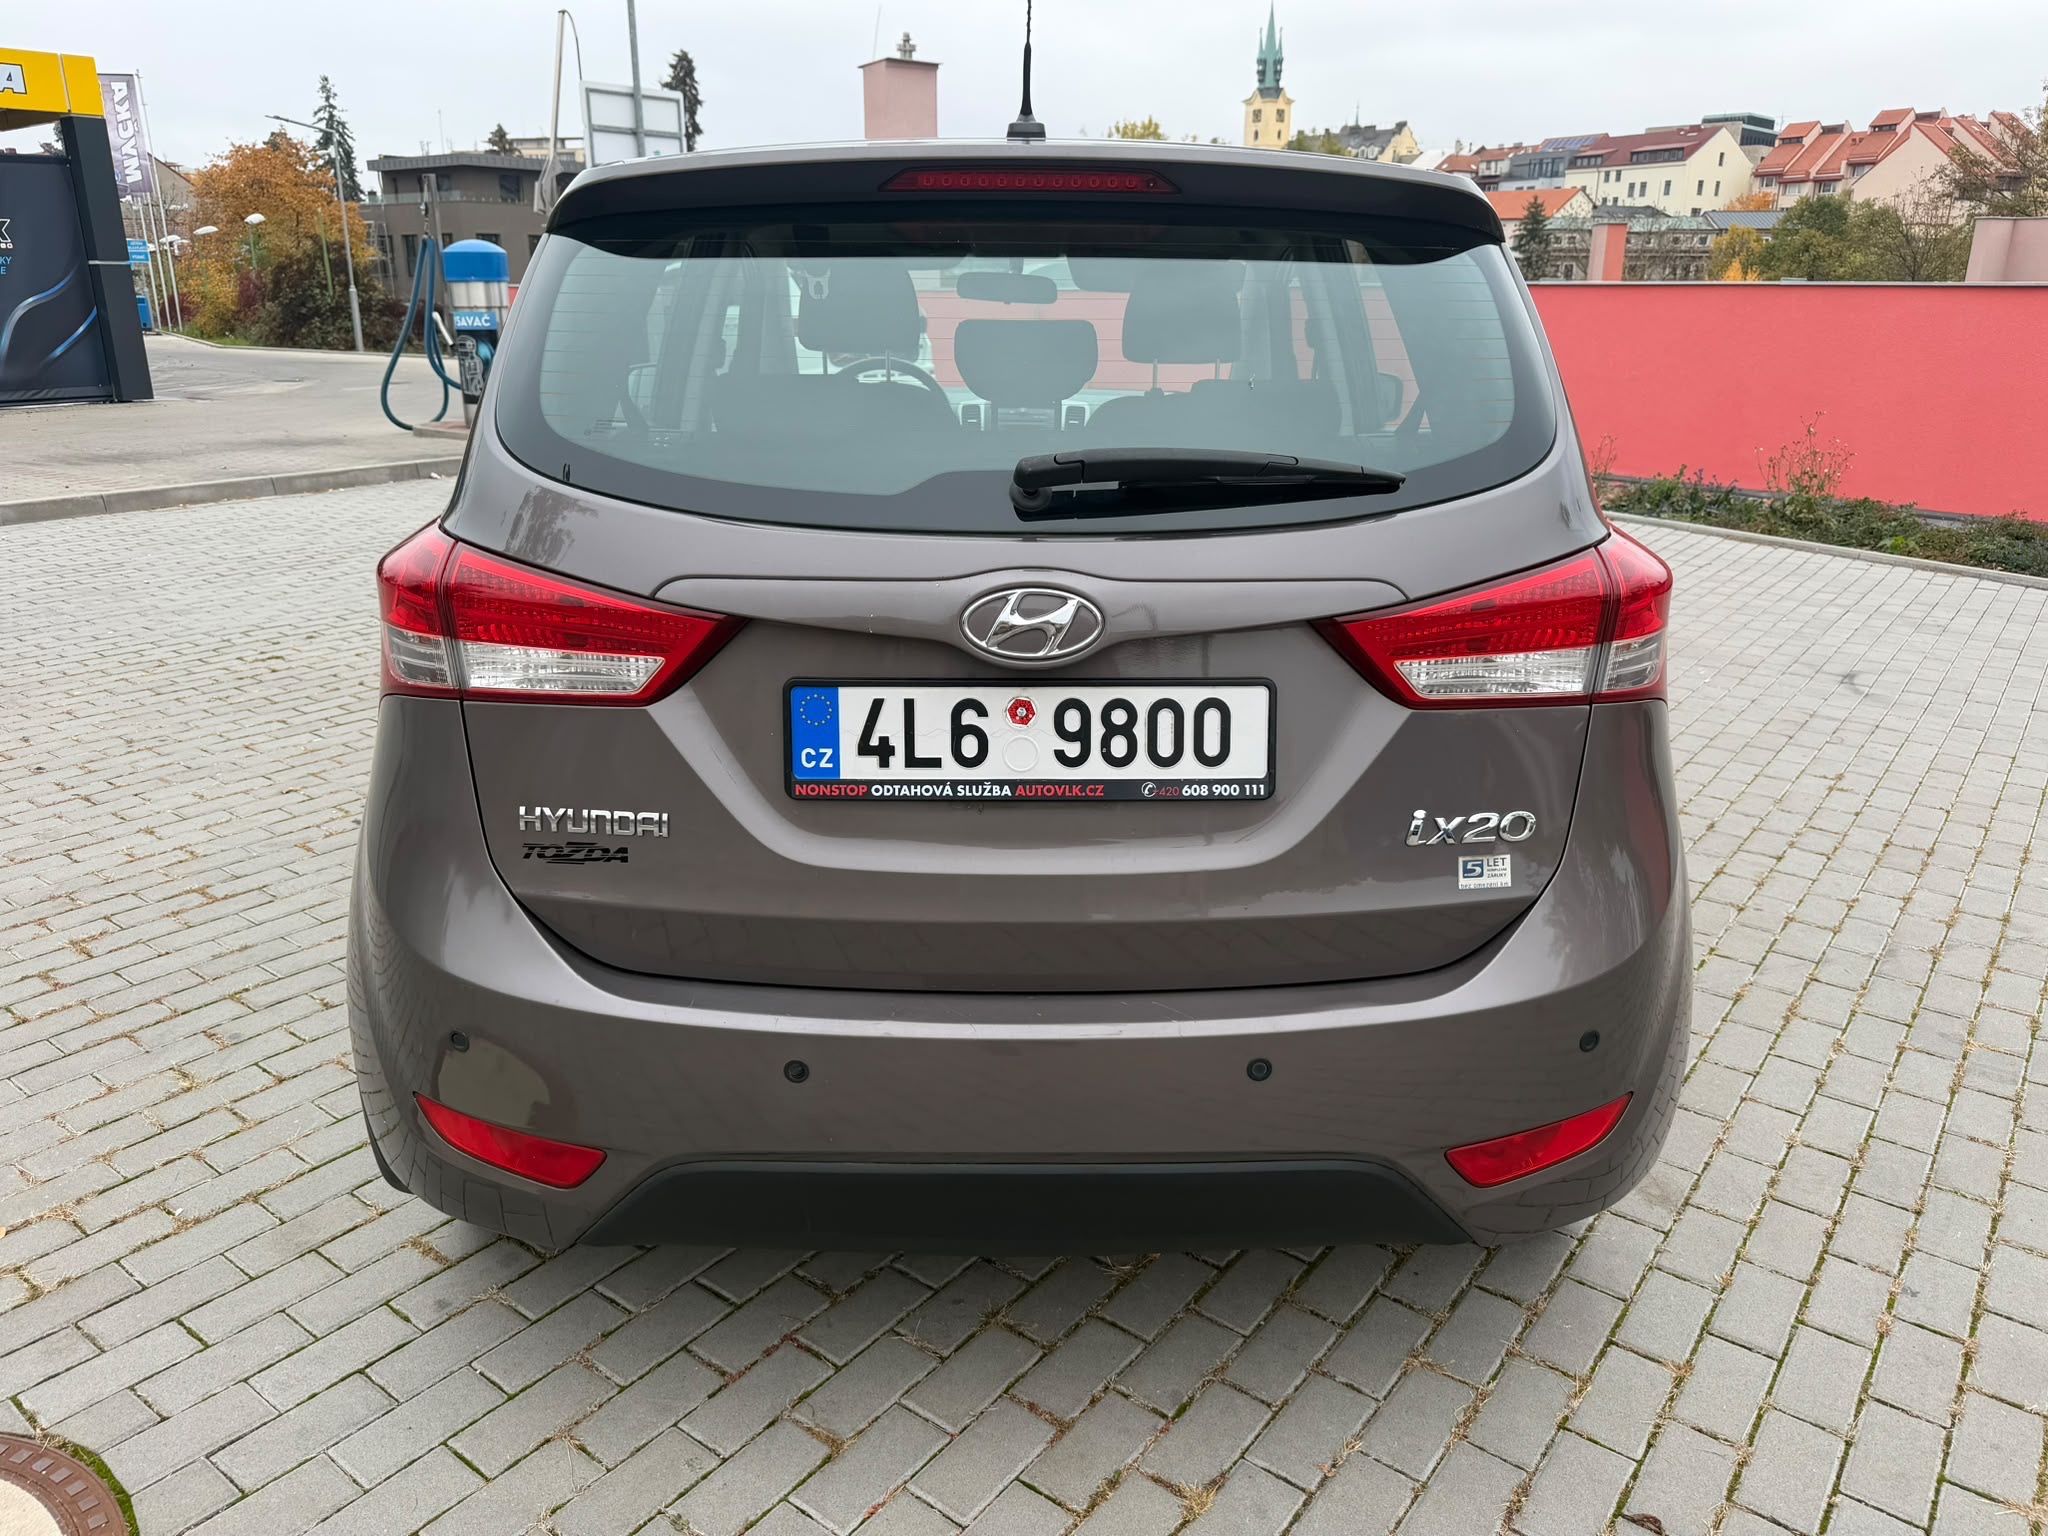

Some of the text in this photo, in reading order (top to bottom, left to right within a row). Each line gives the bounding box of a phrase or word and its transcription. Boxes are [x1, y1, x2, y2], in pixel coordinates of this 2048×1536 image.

[857, 697, 1232, 769] 4L6 9800
[801, 748, 834, 768] CZ
[795, 784, 868, 797] NONSTOP
[871, 782, 953, 797] ODTAHOVÁ
[957, 781, 1012, 797] SLUŽBA
[1015, 784, 1105, 797] AUTOVLK.CZ
[1182, 784, 1209, 797] 608
[1212, 784, 1240, 797] 900
[1244, 784, 1265, 796] 111
[519, 805, 669, 838] HYUNDAI
[1406, 809, 1537, 847] ix20
[1463, 857, 1507, 877] 5 LET
